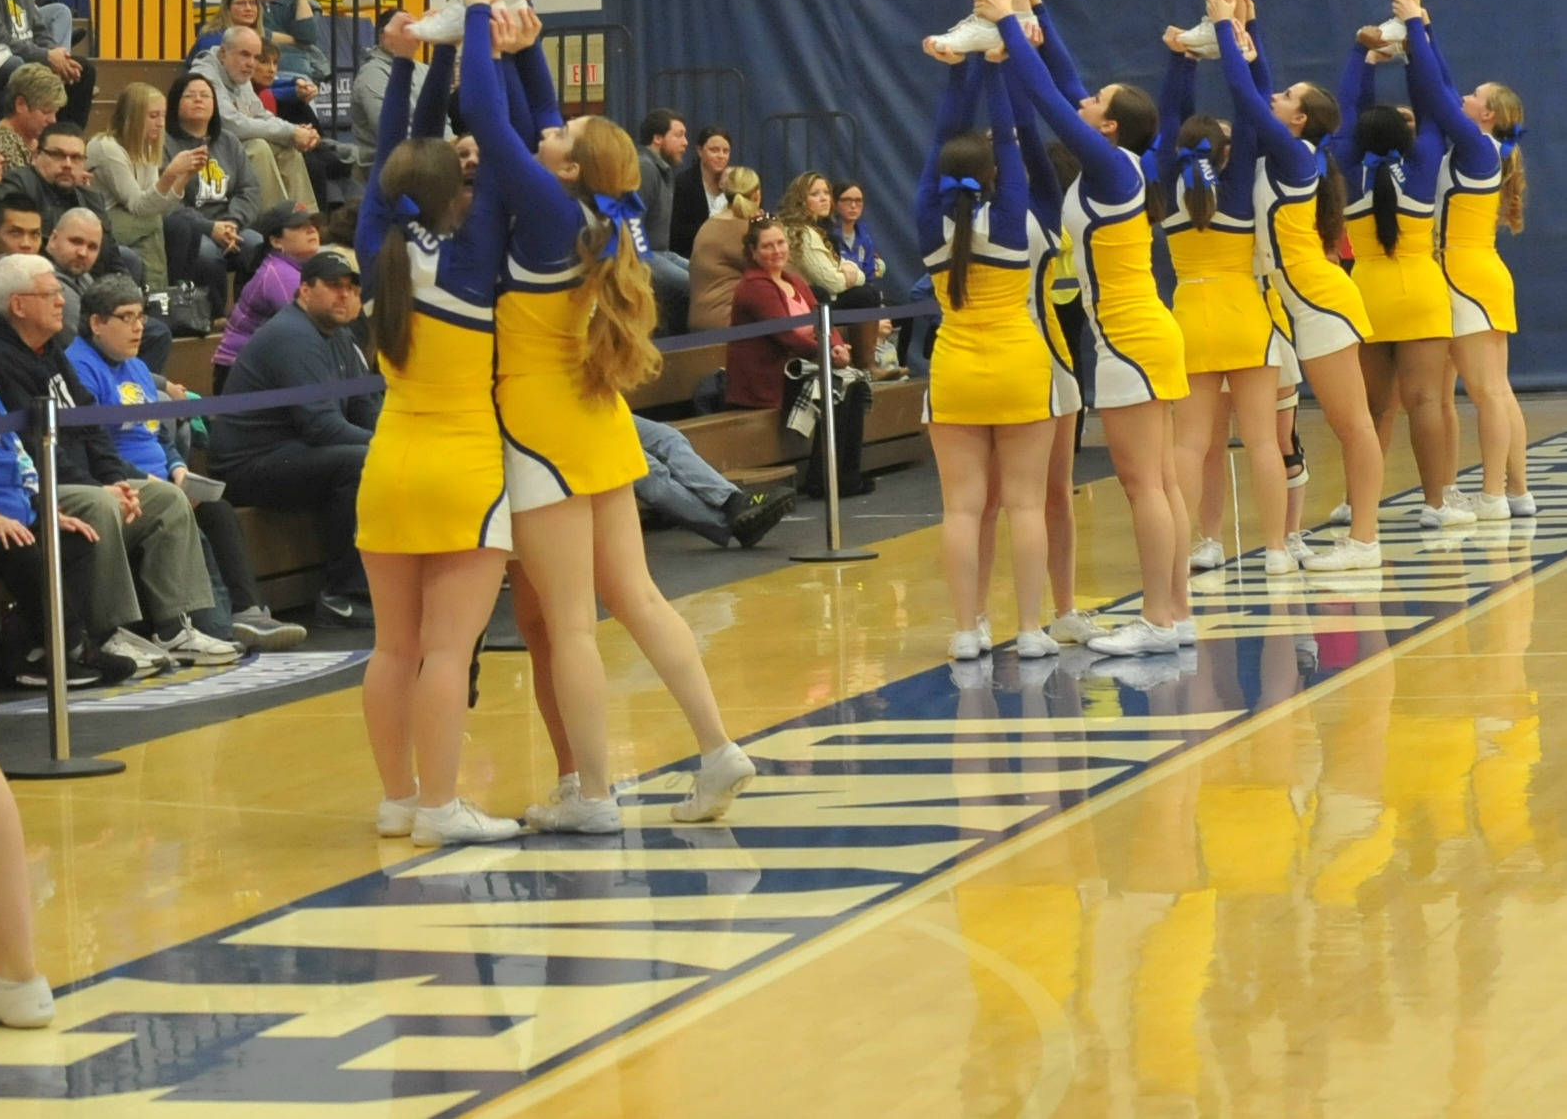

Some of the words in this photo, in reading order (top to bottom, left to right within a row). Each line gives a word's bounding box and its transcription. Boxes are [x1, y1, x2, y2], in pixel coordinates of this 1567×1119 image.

[573, 64, 598, 83] EIT
[1198, 158, 1215, 181] MU
[1389, 163, 1407, 183] MU
[407, 221, 439, 251] MU
[628, 217, 648, 253] MU
